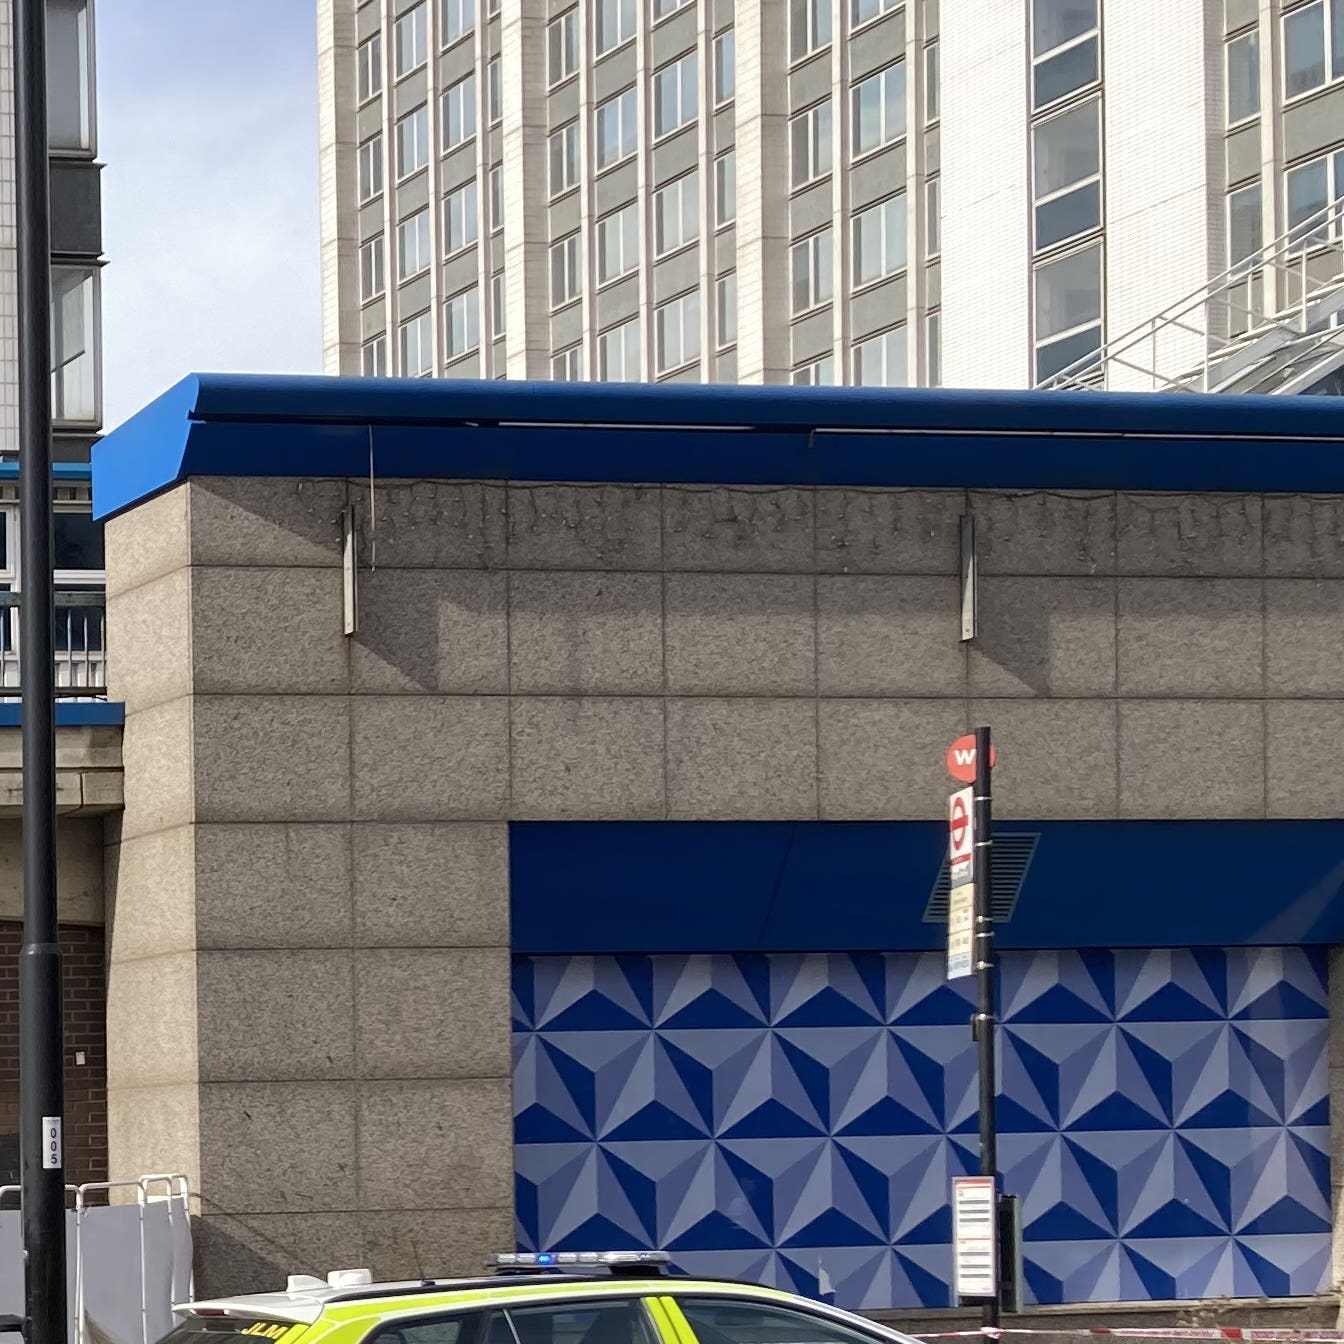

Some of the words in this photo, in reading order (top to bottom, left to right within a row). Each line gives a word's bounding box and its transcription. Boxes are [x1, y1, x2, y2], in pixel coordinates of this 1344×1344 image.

[954, 748, 977, 766] W
[50, 1127, 58, 1165] 005
[240, 1322, 289, 1340] JLM
